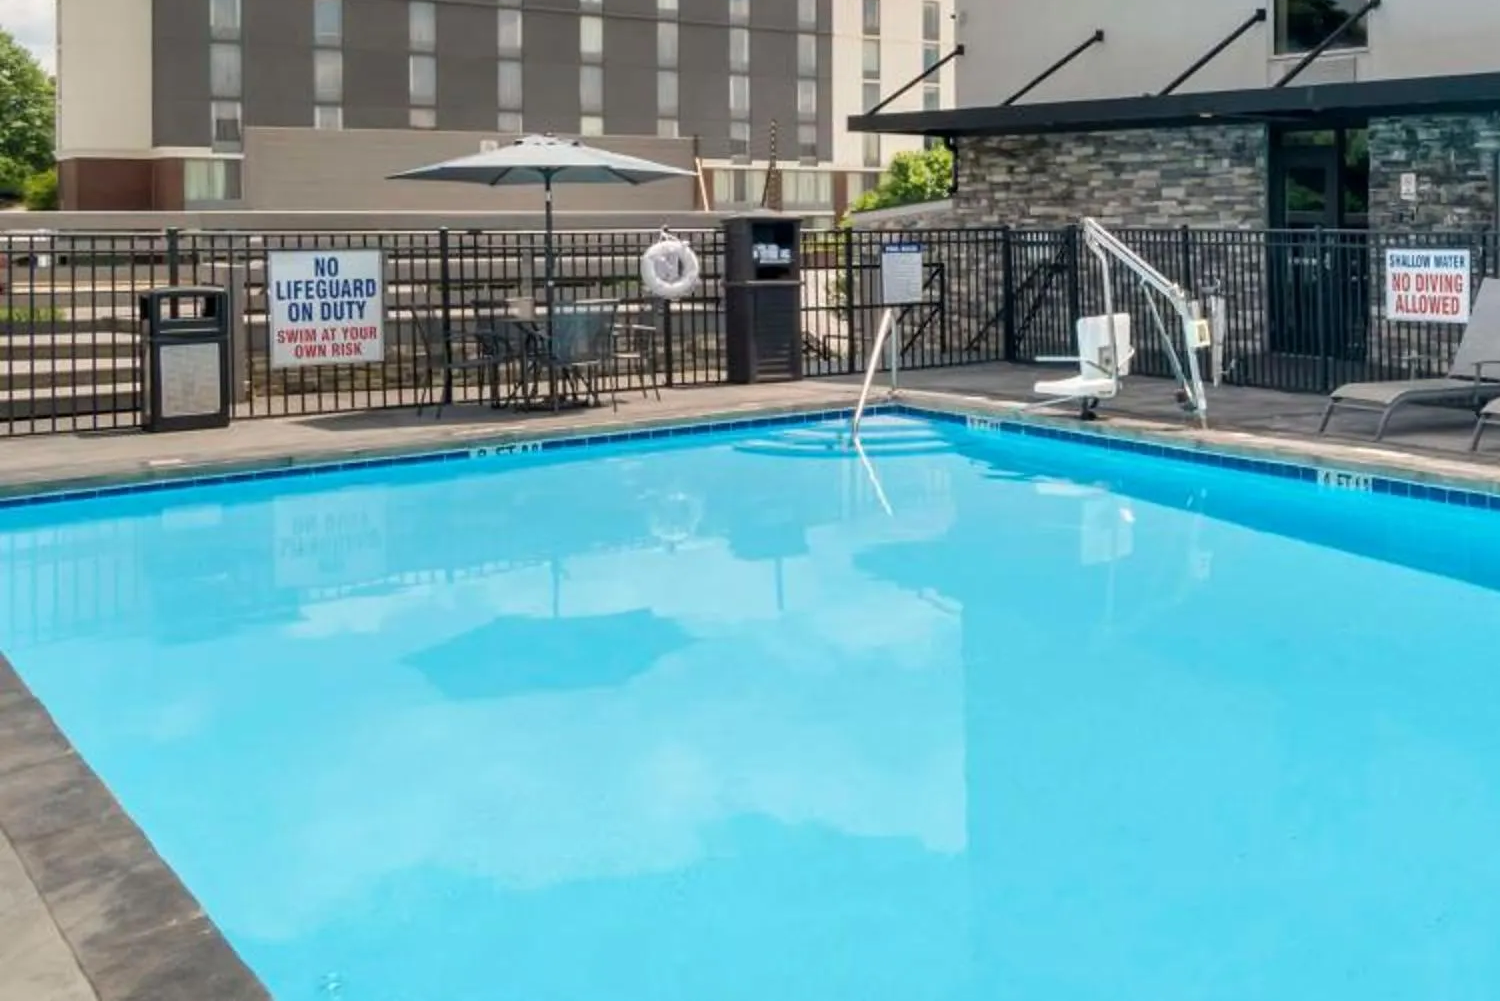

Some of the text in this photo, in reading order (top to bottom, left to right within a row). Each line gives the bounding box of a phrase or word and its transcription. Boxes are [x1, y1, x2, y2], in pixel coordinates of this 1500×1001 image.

[314, 257, 339, 277] NO
[1433, 254, 1465, 268] WATER
[275, 278, 377, 301] LIFEGUARD
[1391, 273, 1463, 293] NO DIVING
[287, 300, 367, 322] ON DUTY
[1395, 294, 1460, 315] ALLOWED
[277, 326, 378, 344] SWIM AT YOUR
[294, 342, 363, 359] OWN RISK
